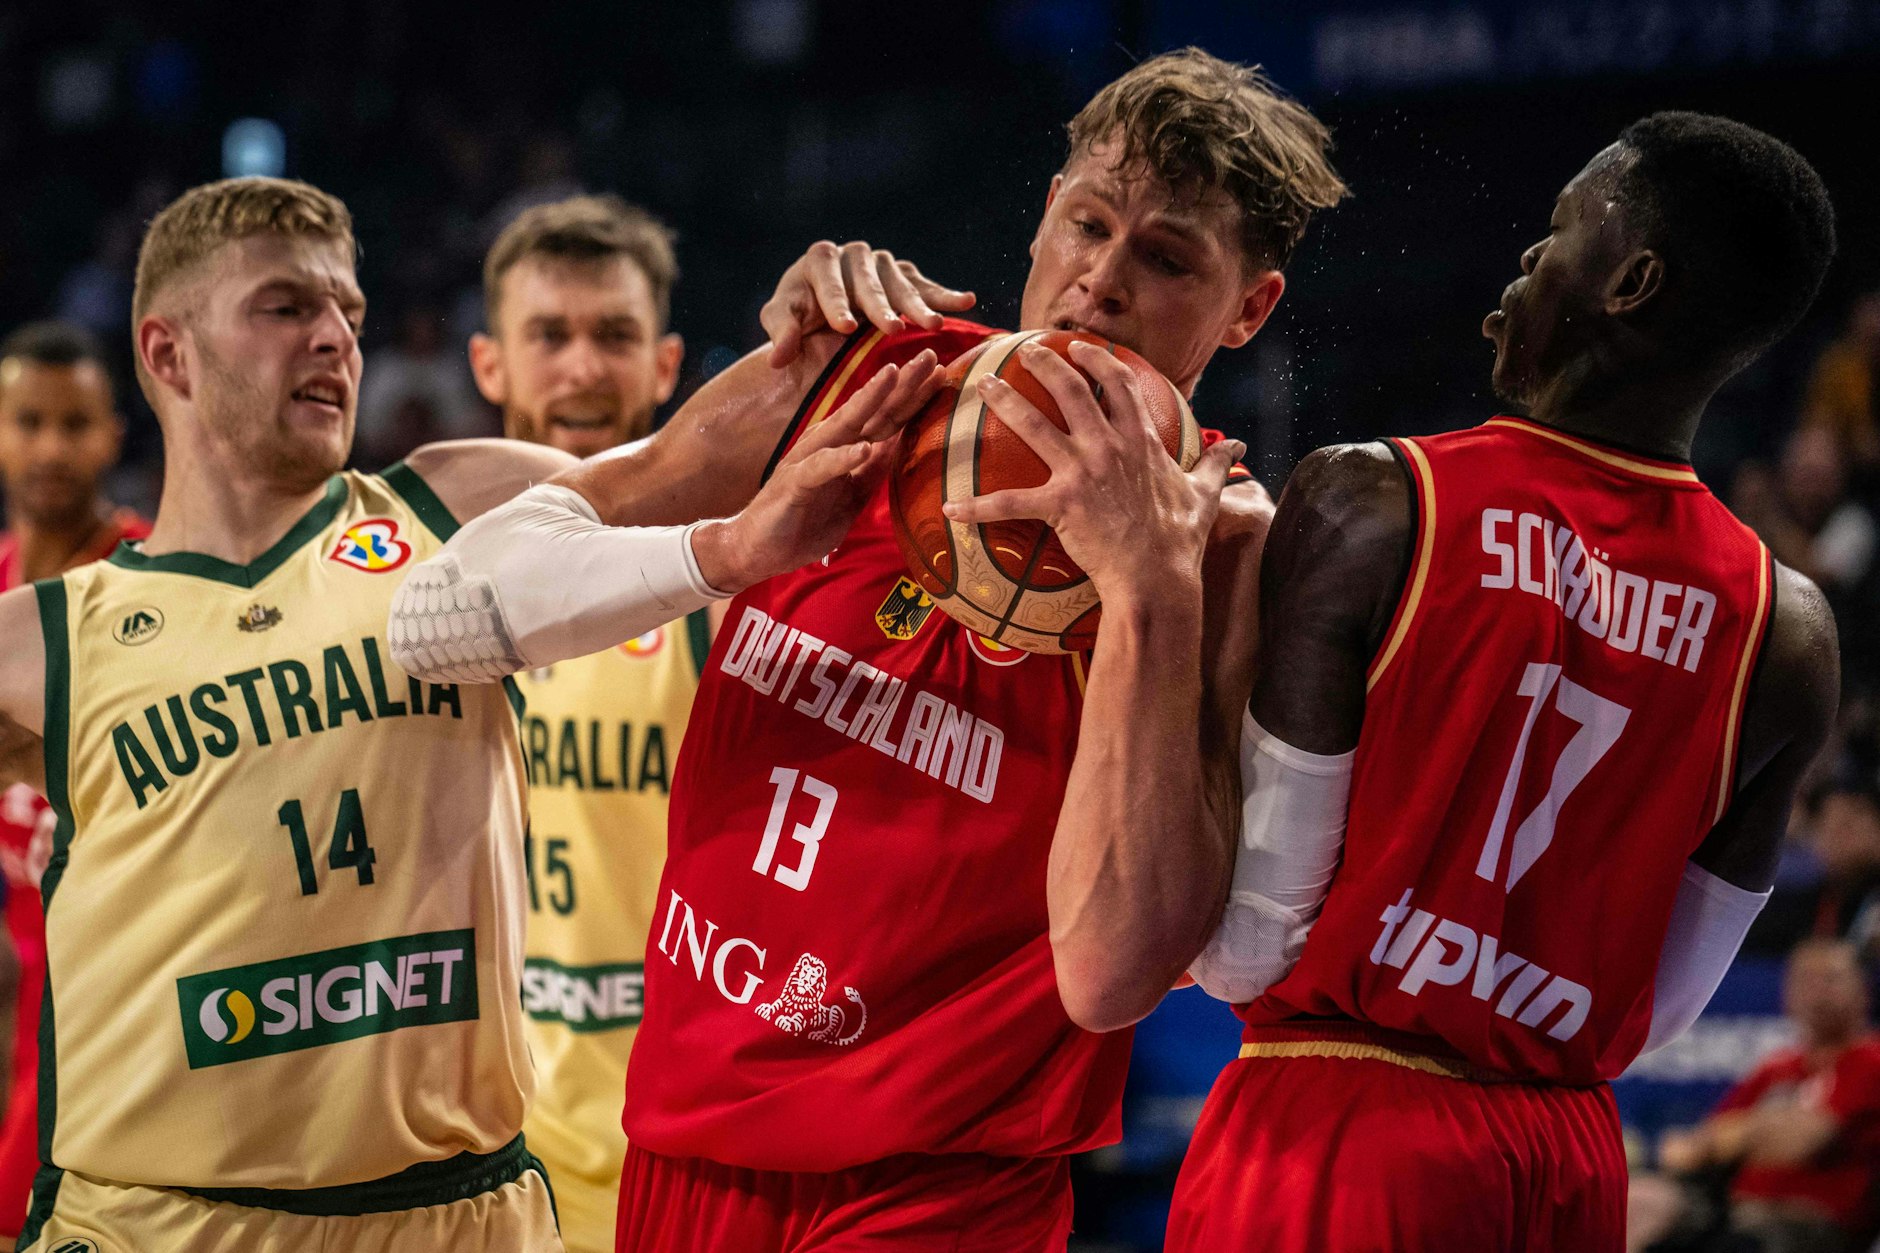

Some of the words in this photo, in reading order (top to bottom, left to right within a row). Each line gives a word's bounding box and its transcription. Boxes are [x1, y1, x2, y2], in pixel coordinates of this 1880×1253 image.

[1481, 508, 1717, 673] SCHRÖDER
[752, 766, 838, 892] 13
[1475, 662, 1633, 895] 17
[278, 788, 376, 896] 14
[260, 948, 464, 1036] SIGNET
[658, 888, 767, 1005] ING
